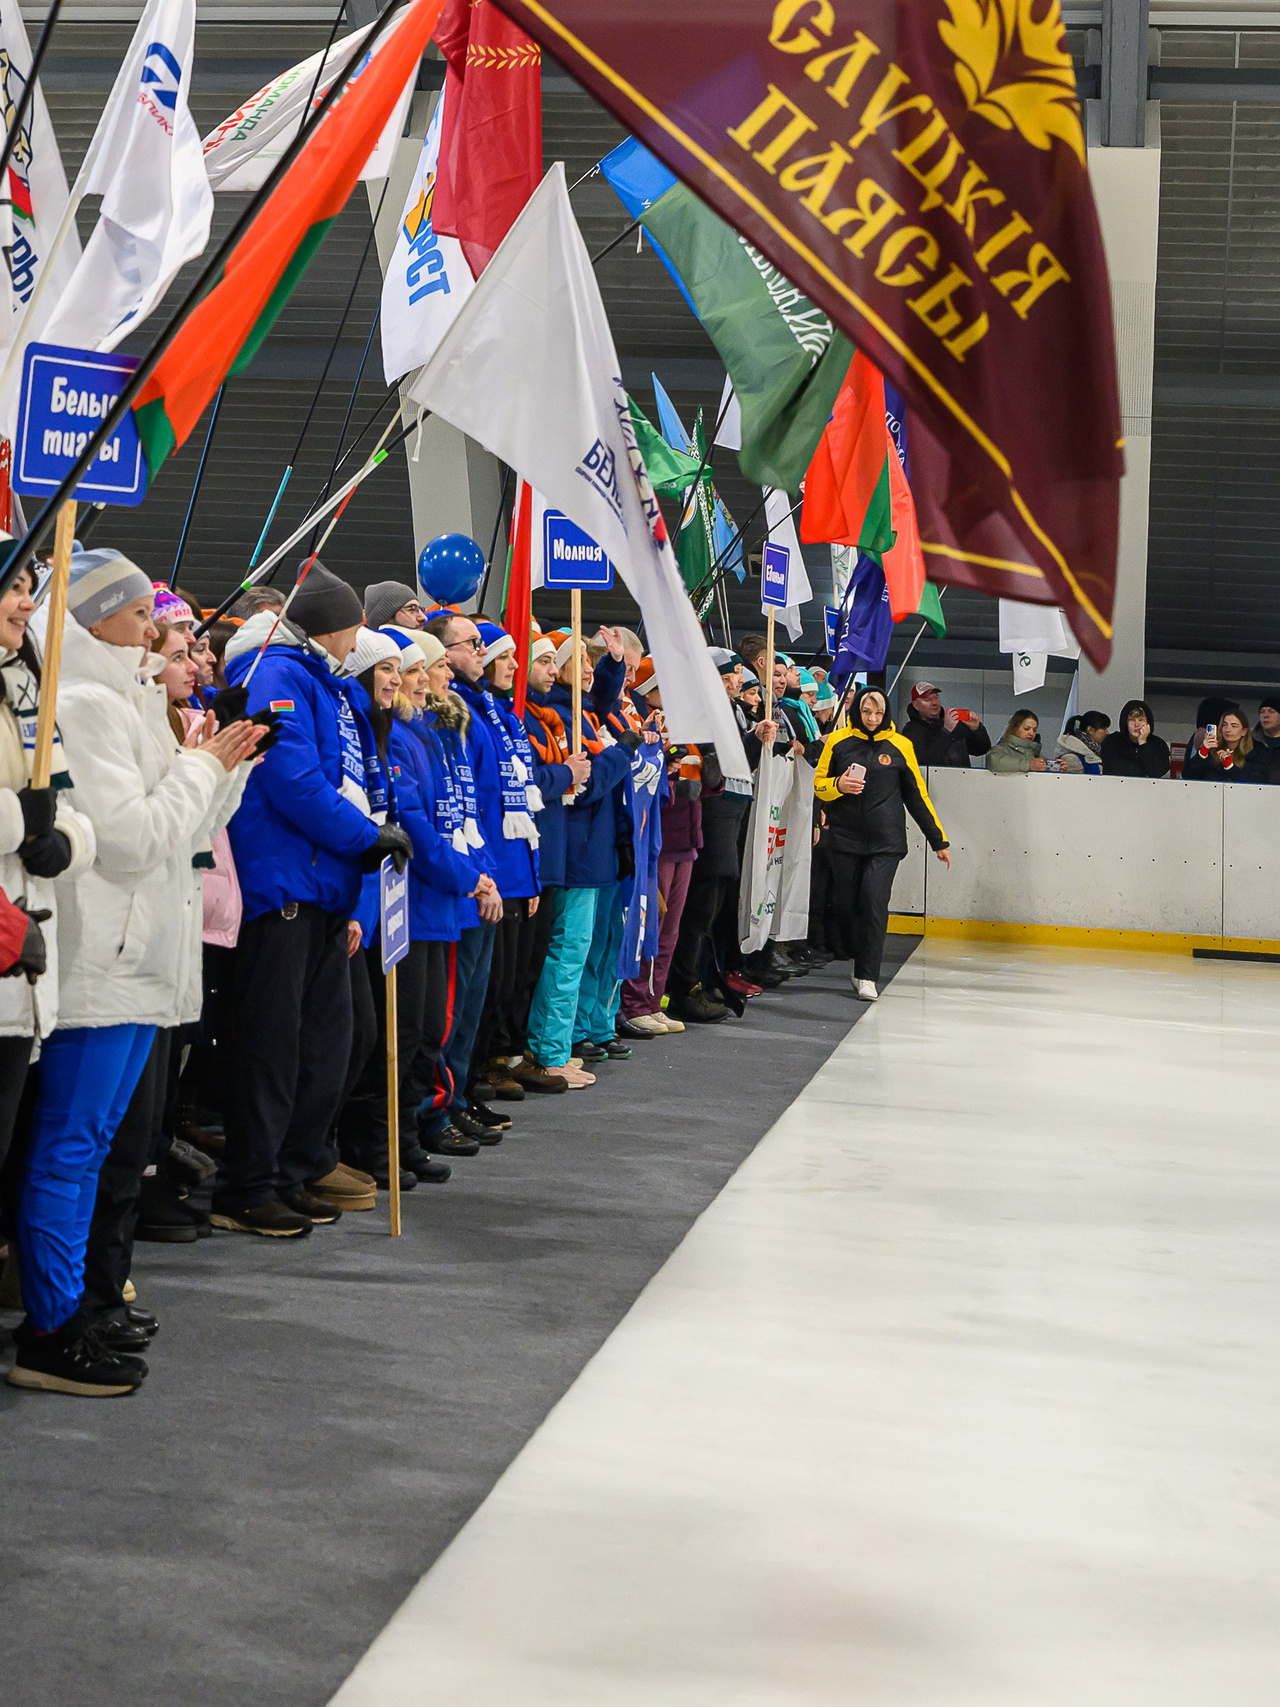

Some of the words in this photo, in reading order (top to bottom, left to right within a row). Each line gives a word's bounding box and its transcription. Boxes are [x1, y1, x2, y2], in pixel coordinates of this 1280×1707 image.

[726, 84, 989, 363] ПАЯСЫ
[42, 429, 121, 471] тигы
[553, 538, 602, 562] Молния
